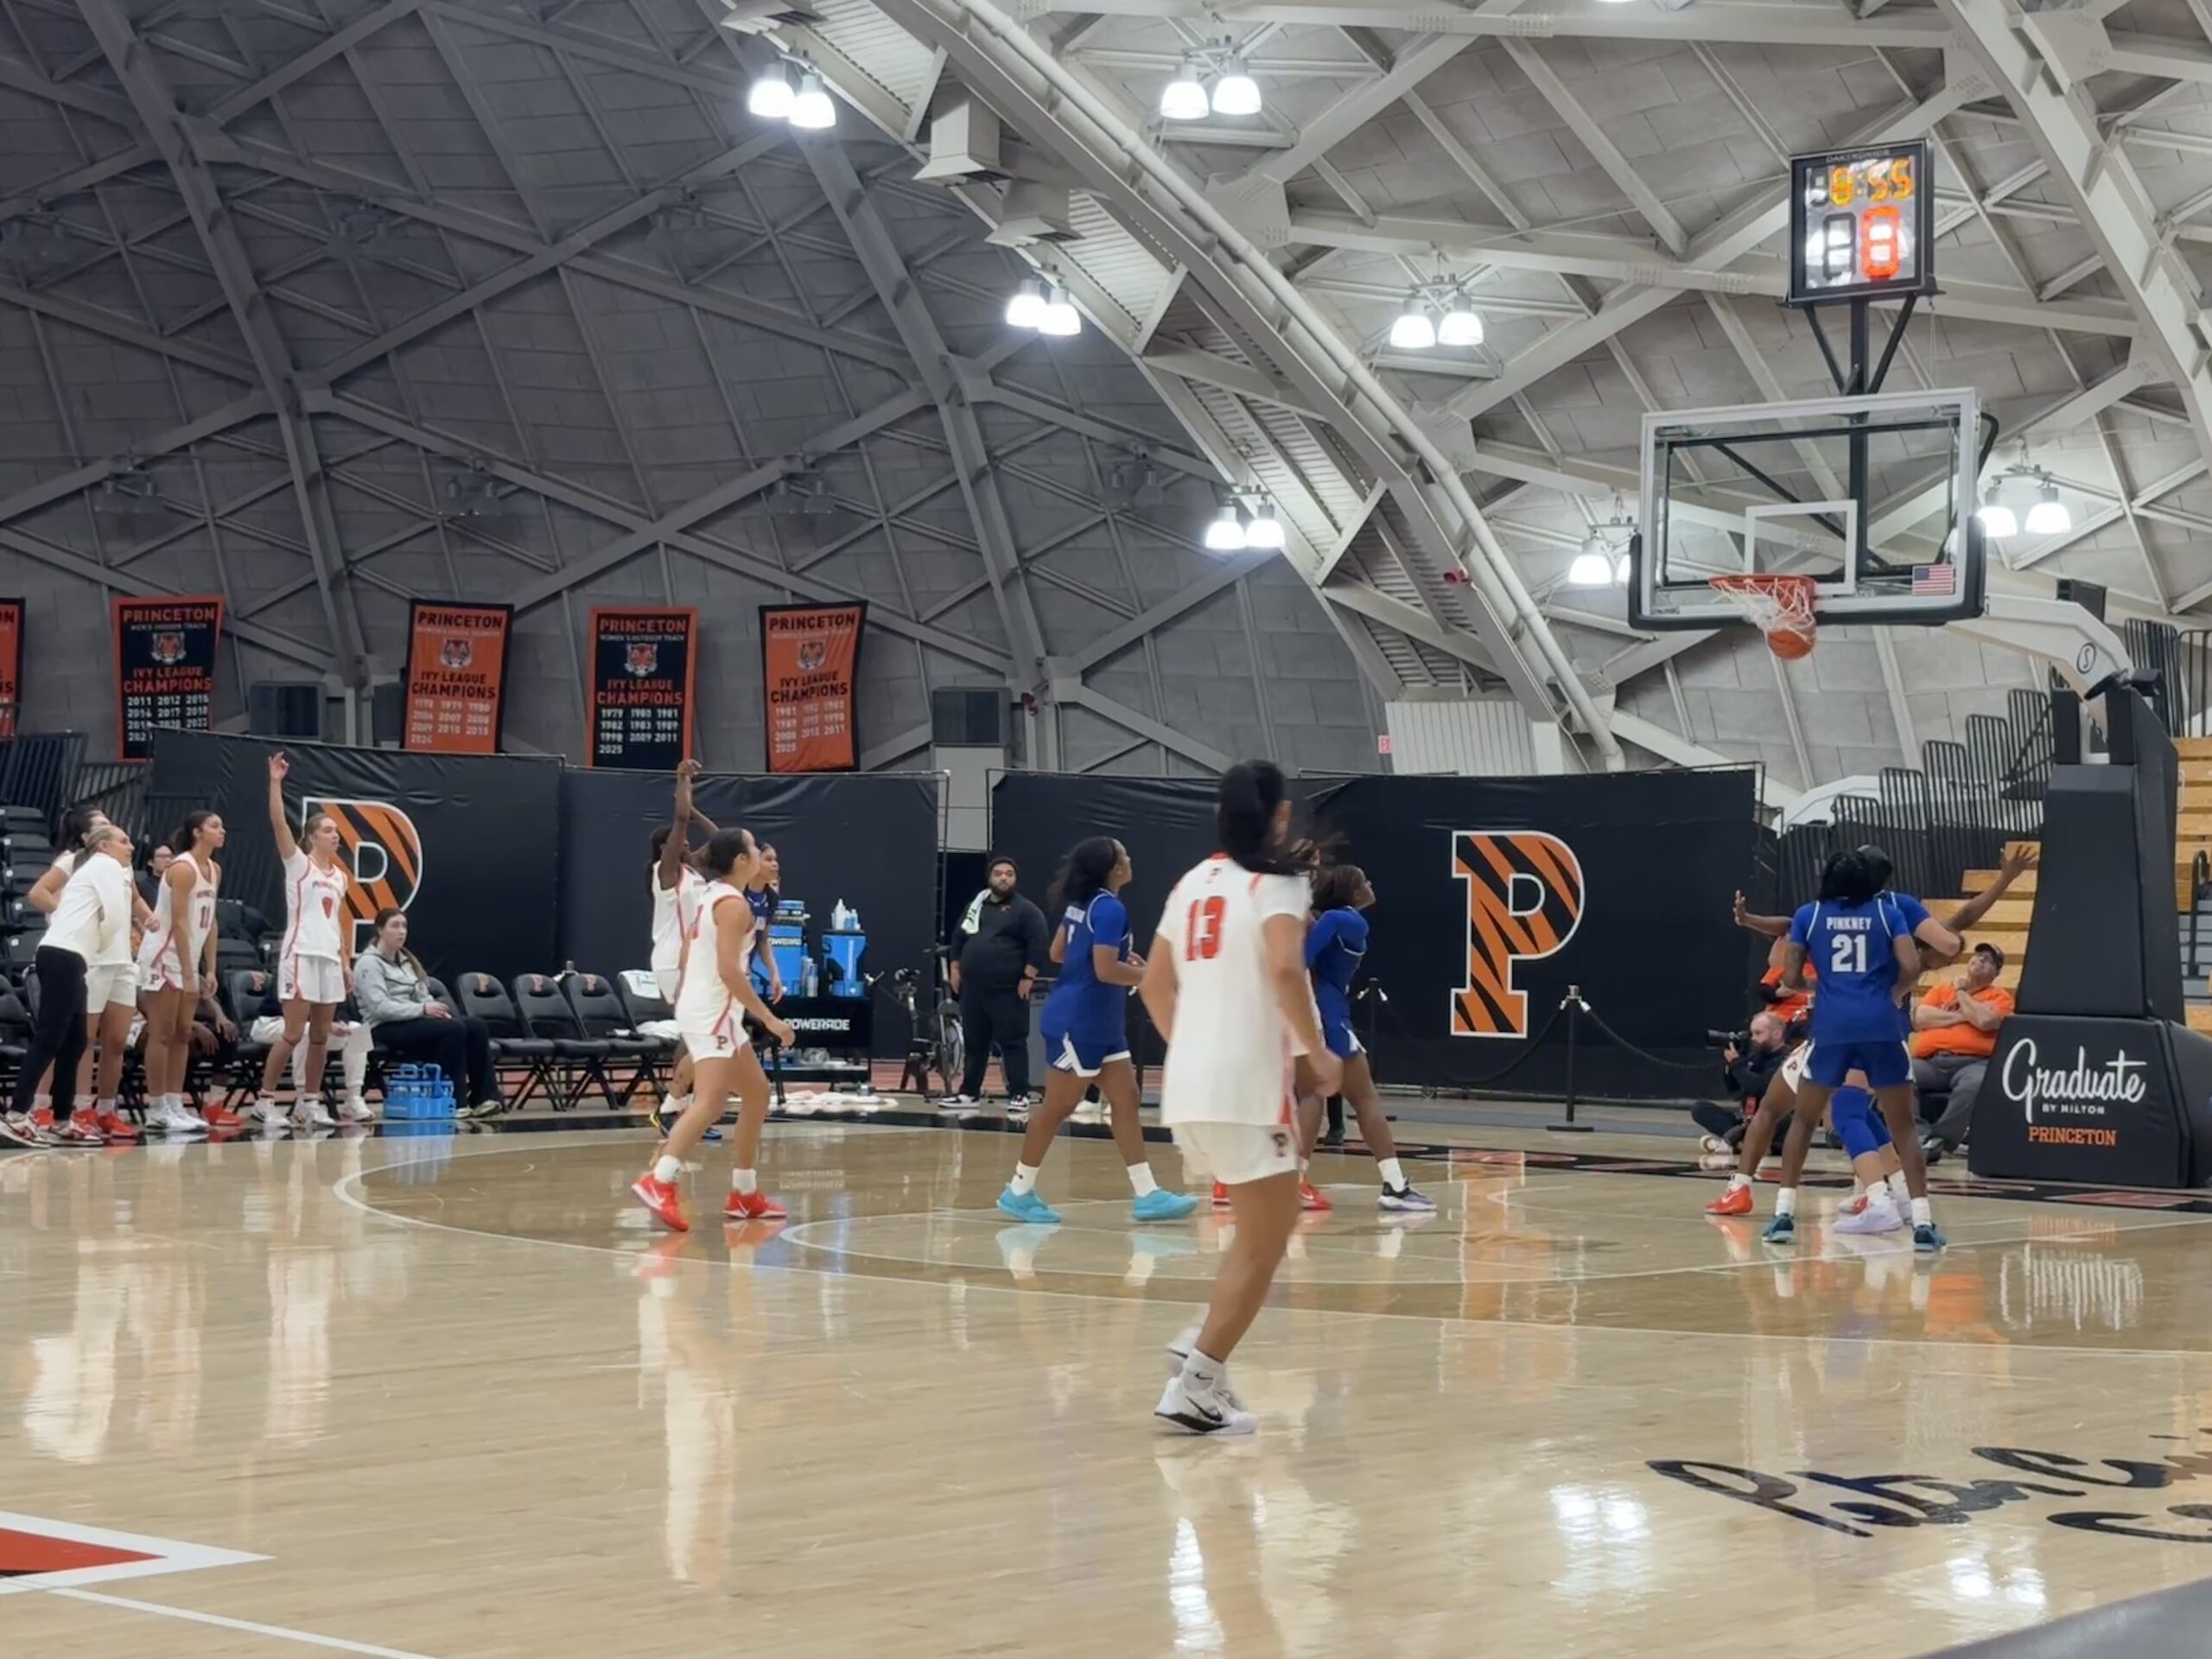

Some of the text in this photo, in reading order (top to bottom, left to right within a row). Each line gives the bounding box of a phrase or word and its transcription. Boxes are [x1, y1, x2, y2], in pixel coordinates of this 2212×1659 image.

[123, 607, 215, 622] PRINCETON
[417, 612, 503, 628] PRINCETON
[769, 613, 855, 631] PRINCETON
[600, 620, 686, 632] PRINCETON
[133, 666, 203, 678] IVY LEAGUE
[421, 671, 487, 684] IVY LEAGUE
[780, 671, 838, 688] IVY LEAGUE
[124, 679, 213, 694] CHAMPIONS
[411, 683, 496, 699] CHAMPIONS
[607, 679, 673, 690] IVY LEAGUE
[597, 691, 683, 705] CHAMPIONS
[771, 683, 849, 703] CHAMPIONS
[127, 696, 152, 707] 2011
[823, 723, 846, 735] 2011
[654, 733, 677, 743] 2011
[1185, 895, 1228, 962] 13
[1826, 917, 1872, 931] PINKNEY
[1450, 830, 1586, 1039] P
[1831, 933, 1866, 973] 21
[716, 1034, 728, 1050] P
[2002, 1038, 2148, 1124] Graduate
[2028, 1126, 2117, 1146] PRINCETON
